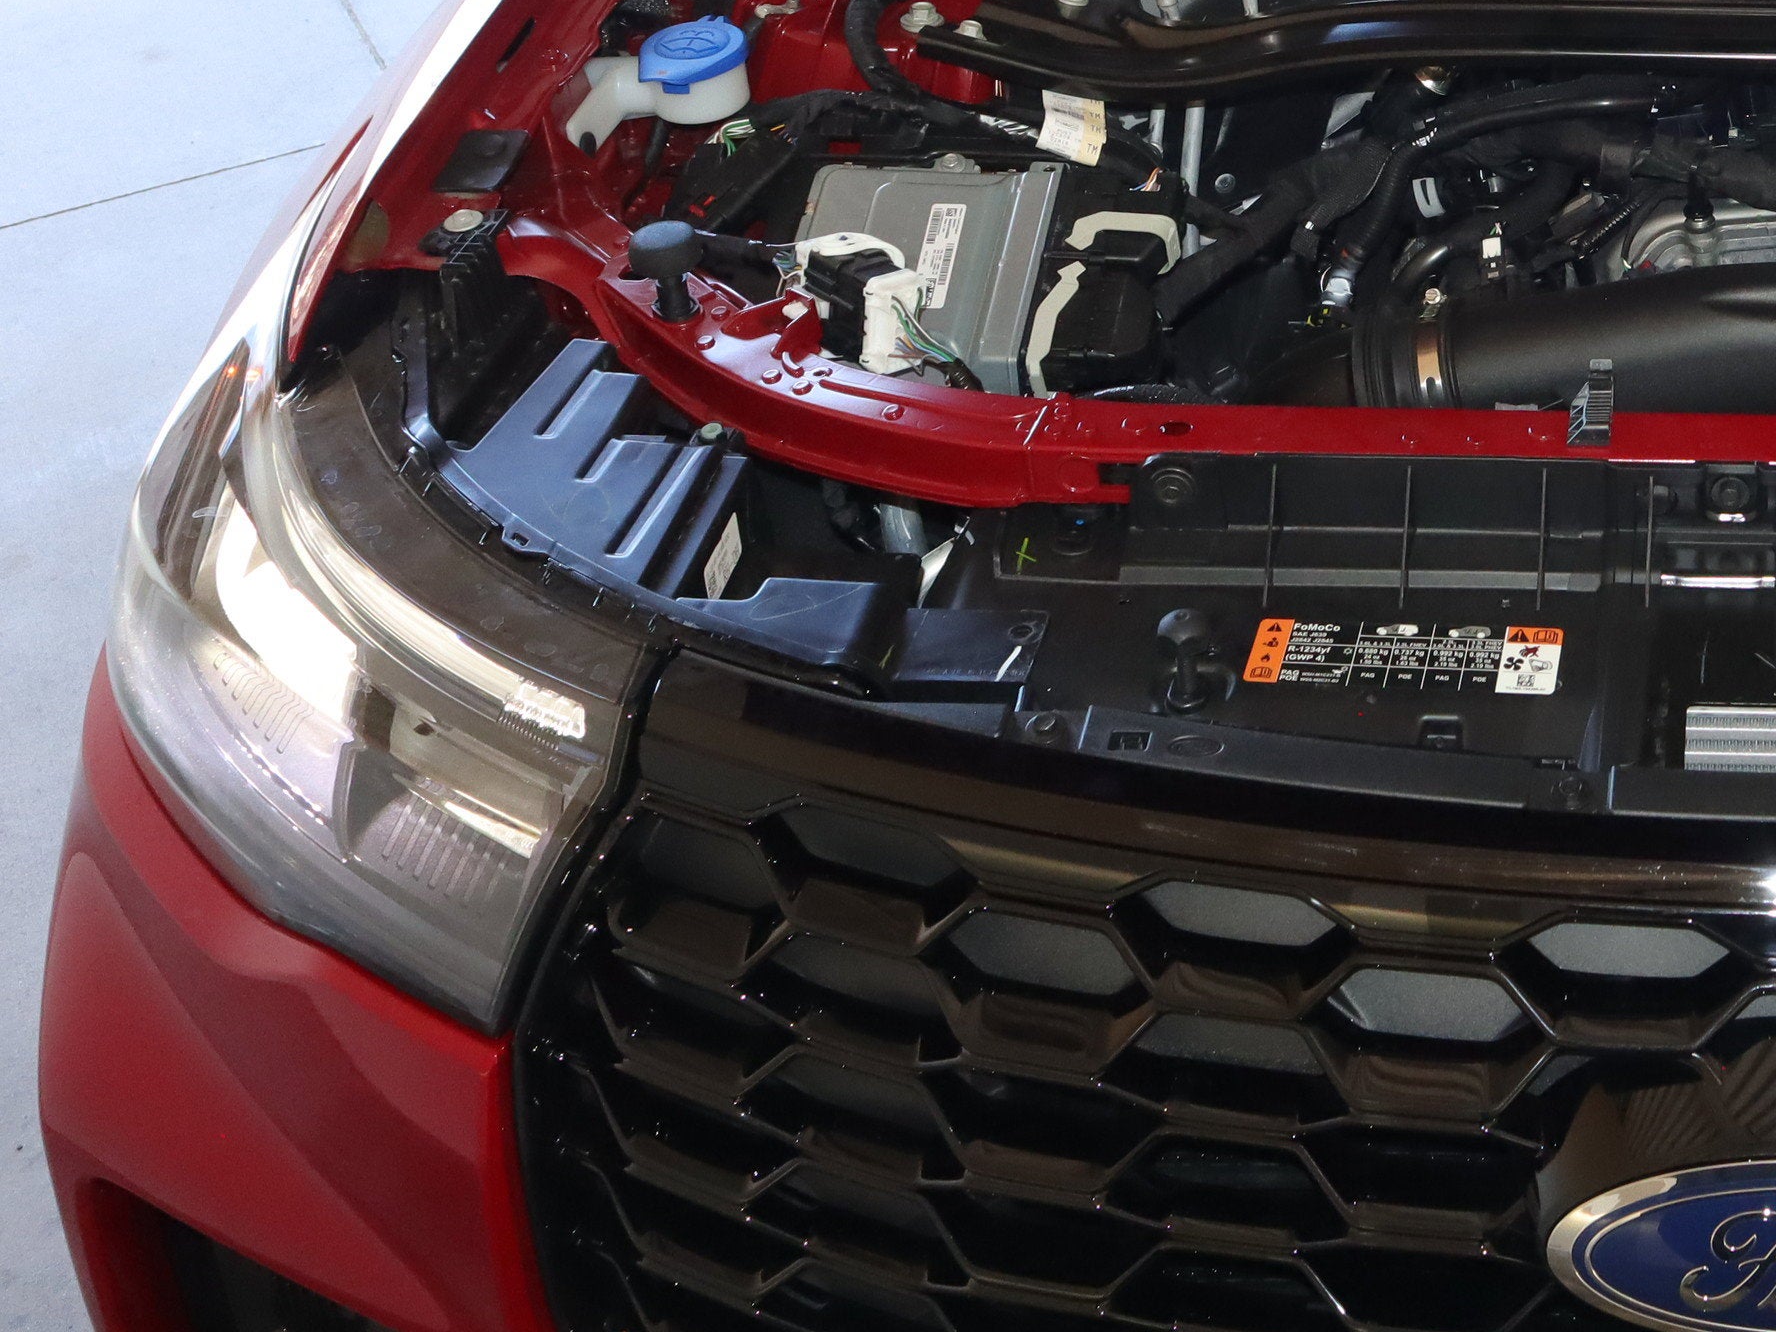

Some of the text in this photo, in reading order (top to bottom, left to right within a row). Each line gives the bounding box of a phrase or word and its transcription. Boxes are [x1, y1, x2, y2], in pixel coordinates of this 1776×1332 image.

[1293, 622, 1341, 632] FoMoCo
[1288, 645, 1331, 654] R-1234yf
[1414, 650, 1425, 658] kg
[1285, 653, 1326, 662] (GWP 4)
